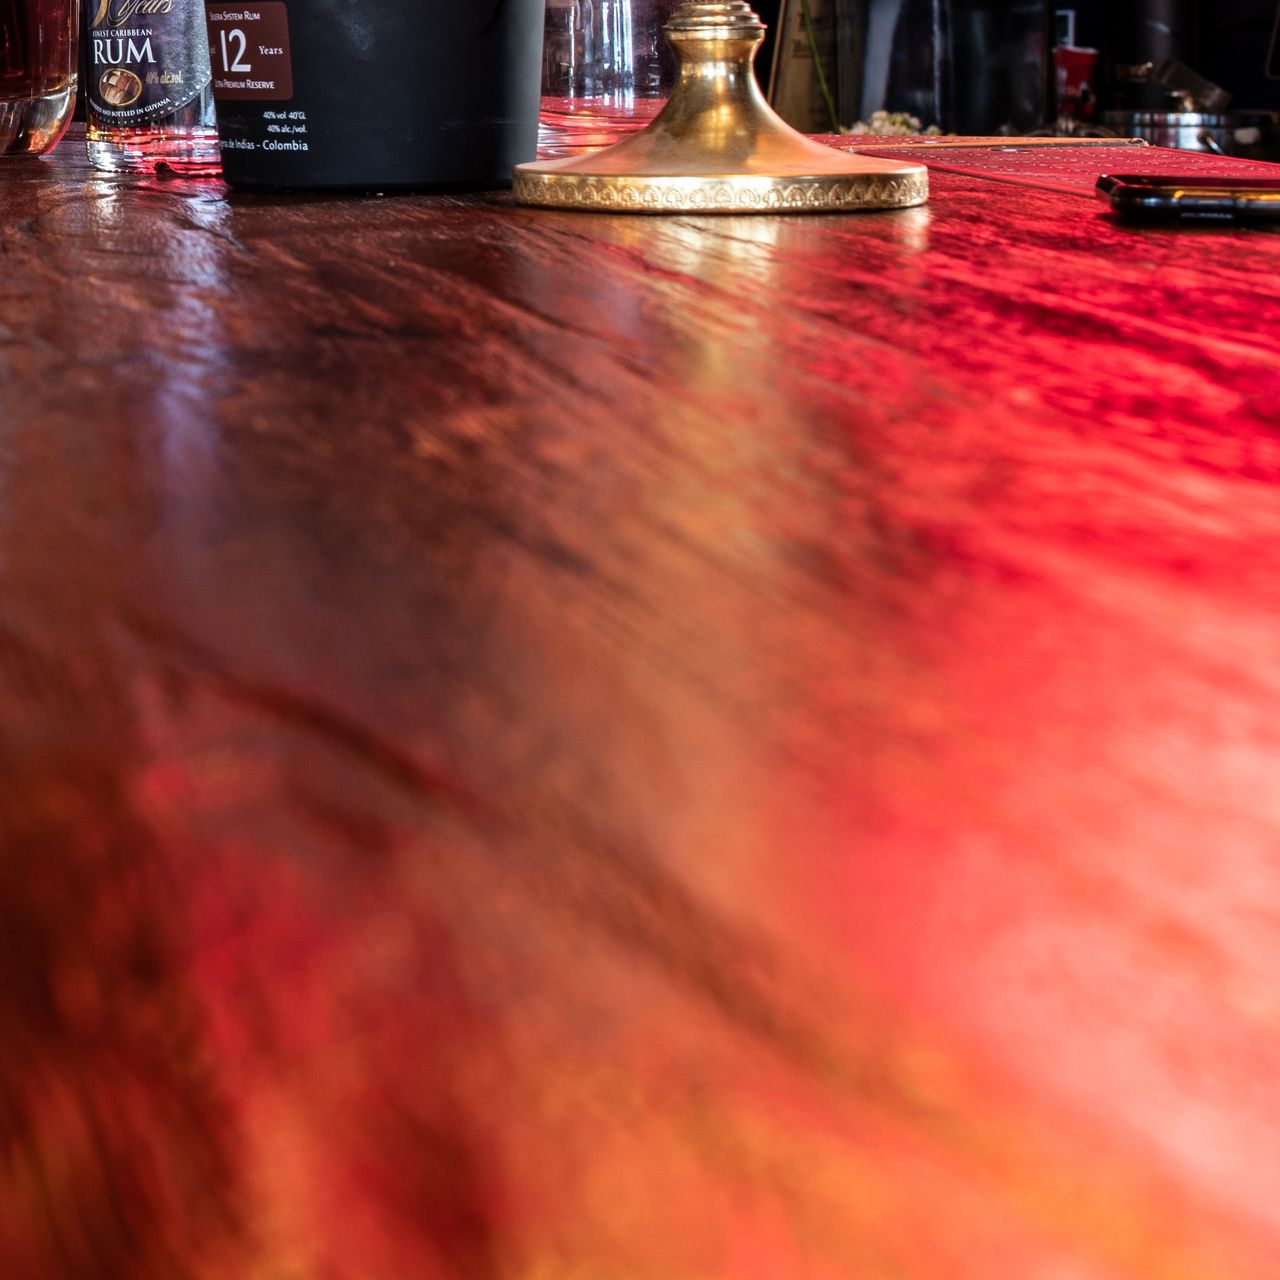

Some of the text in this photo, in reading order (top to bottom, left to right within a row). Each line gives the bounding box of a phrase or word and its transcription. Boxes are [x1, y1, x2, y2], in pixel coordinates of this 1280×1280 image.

[243, 10, 261, 21] RUM
[110, 28, 153, 37] CARIBBEAN
[93, 38, 158, 65] RUM
[220, 28, 284, 73] 12 Years
[246, 79, 275, 90] RESERVE
[144, 97, 172, 113] GUYANA
[235, 140, 255, 150] Indias
[262, 139, 309, 151] Colombia
